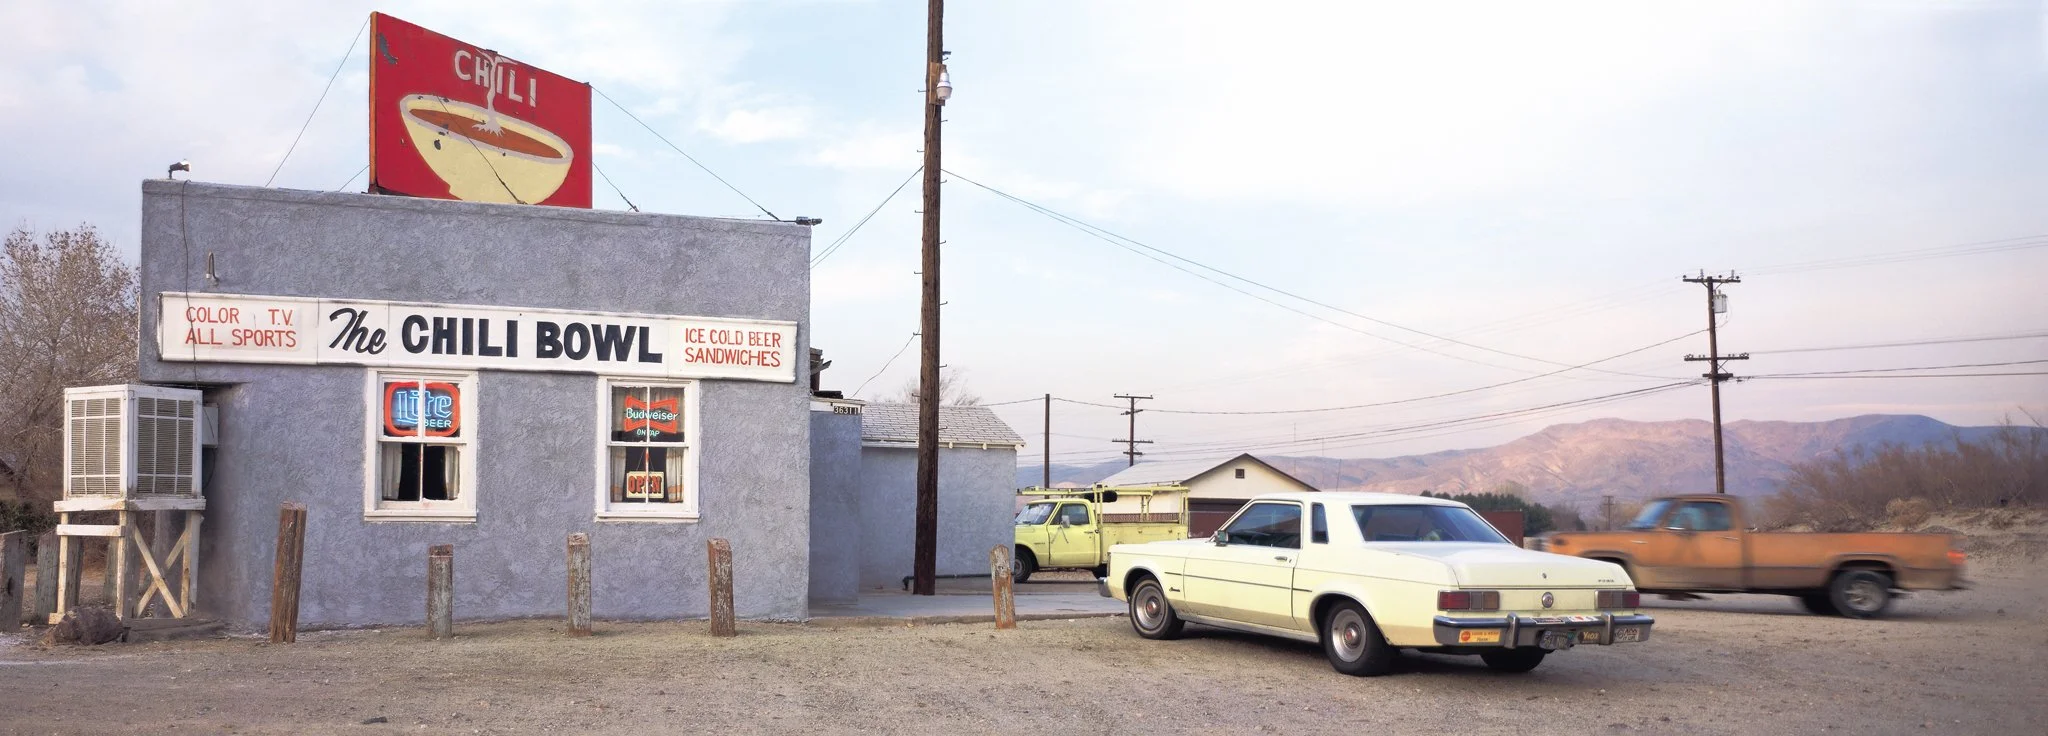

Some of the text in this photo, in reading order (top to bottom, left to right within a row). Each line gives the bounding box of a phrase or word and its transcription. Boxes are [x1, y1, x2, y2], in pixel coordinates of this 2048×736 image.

[454, 50, 537, 108] CHILI
[186, 306, 293, 326] COLOR T.V.
[185, 327, 297, 348] ALL SPORTS
[329, 307, 663, 363] The CHILI BOWL
[685, 328, 781, 348] ICE COLD BEER
[685, 347, 781, 367] SANDWICHES
[396, 389, 453, 424] Lite
[626, 408, 678, 420] Budweiser
[628, 475, 662, 494] OPEN
